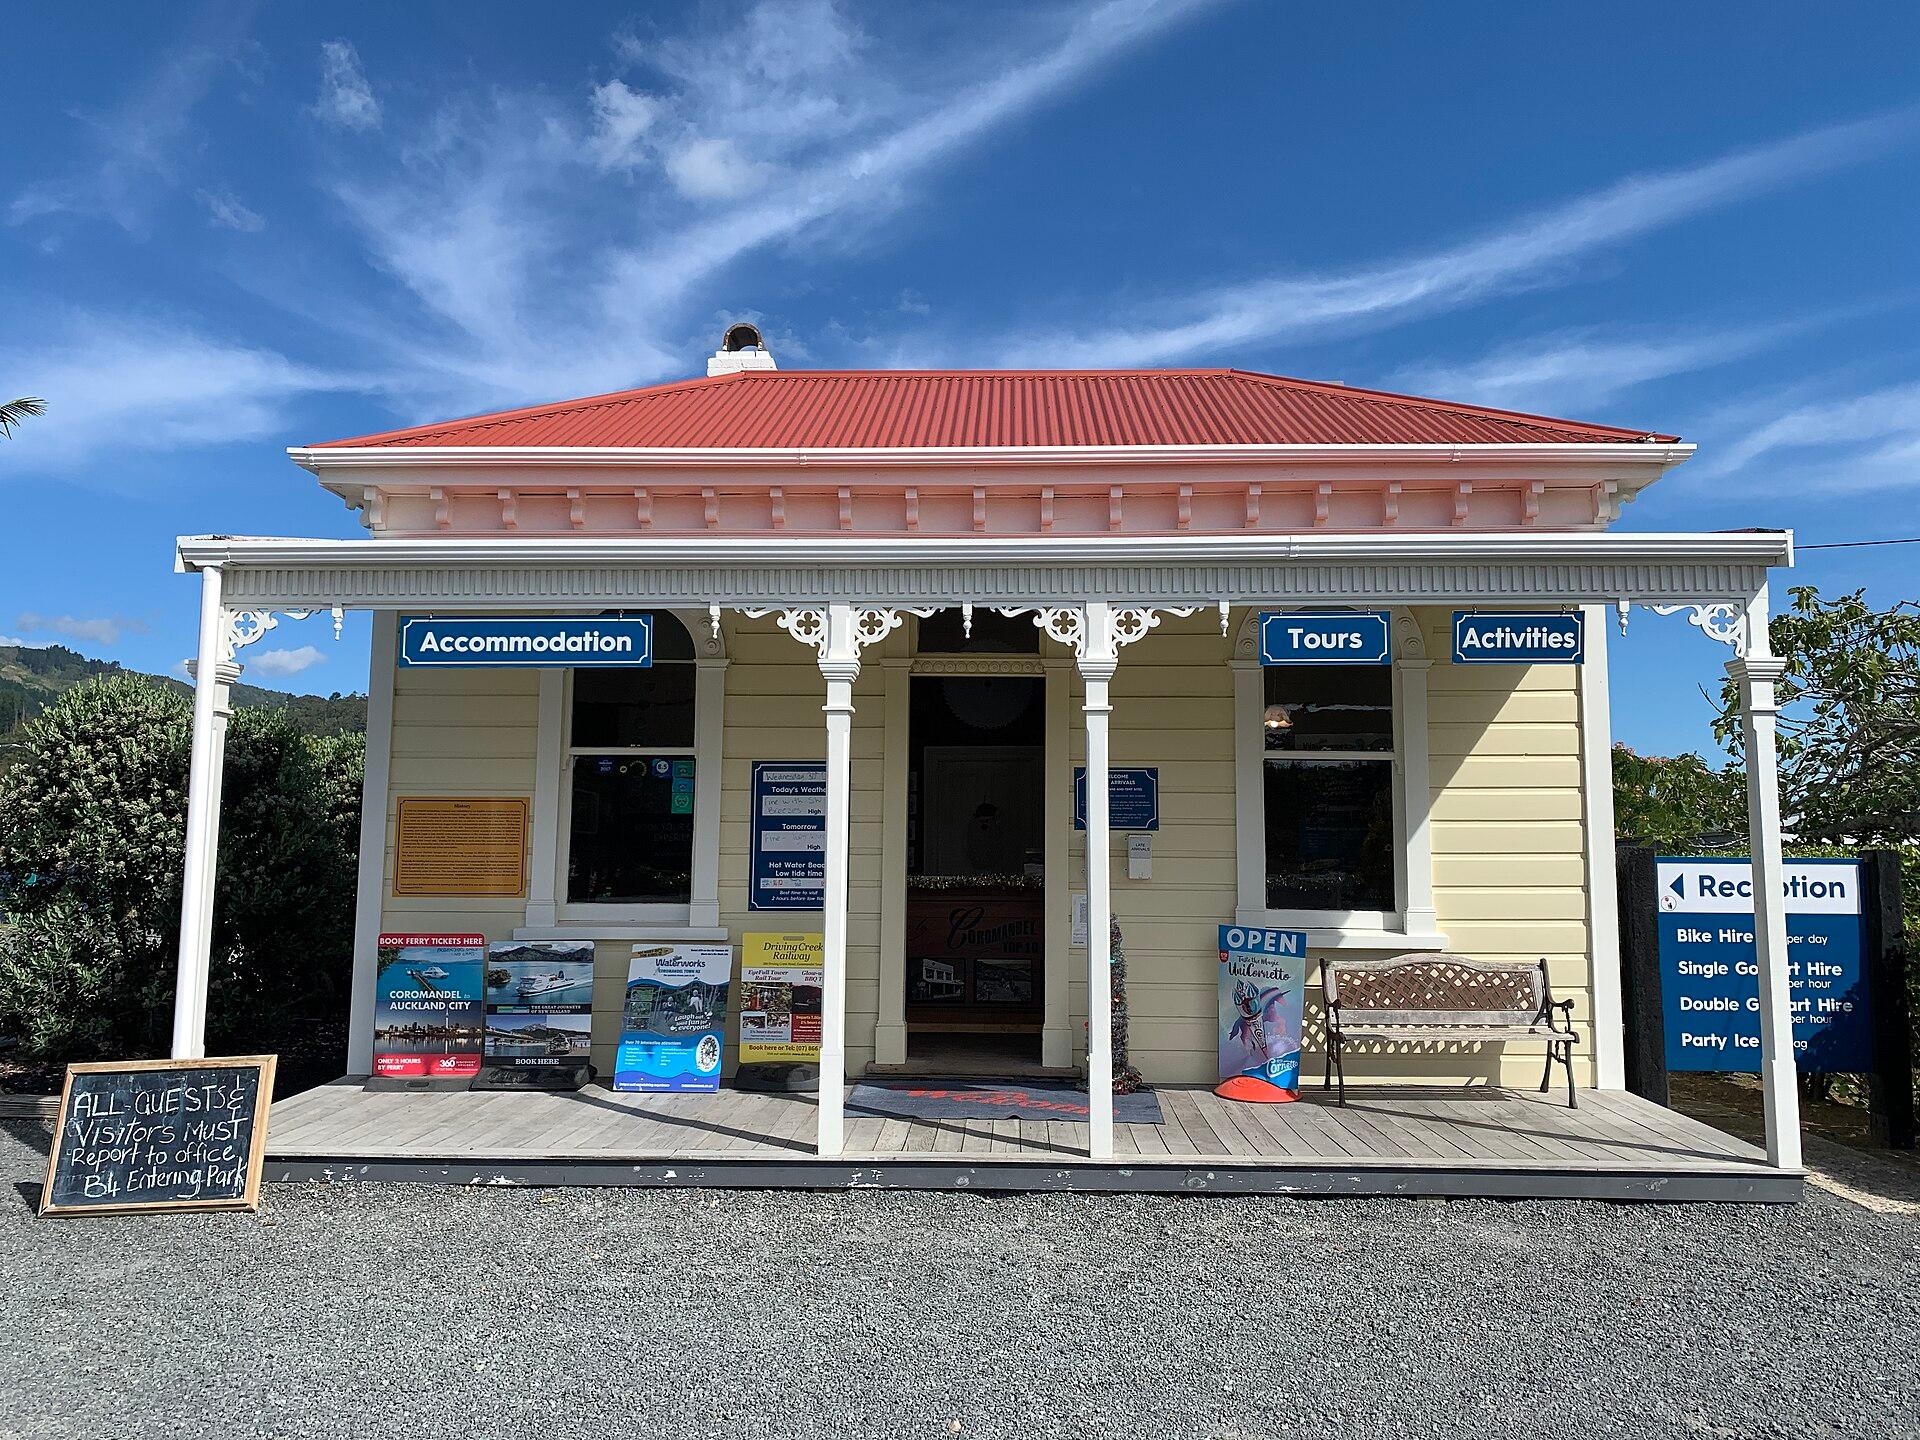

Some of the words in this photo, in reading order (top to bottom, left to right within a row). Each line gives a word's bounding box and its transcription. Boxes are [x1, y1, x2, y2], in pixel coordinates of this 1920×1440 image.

[420, 631, 632, 652] Accommodation
[1287, 628, 1363, 649] Tours
[1462, 626, 1576, 649] Activities
[771, 786, 799, 794] Today's
[1699, 874, 1846, 899] Rection
[380, 937, 404, 945] BOOK
[405, 937, 430, 945] FERRY
[431, 937, 462, 945] TICKETS
[463, 937, 483, 945] HERE
[1226, 928, 1297, 954] OPEN
[1677, 928, 1713, 943] Bike
[1718, 928, 1754, 943] Hire
[1787, 935, 1804, 945] per
[1808, 934, 1828, 946] day
[763, 942, 798, 953] Driving
[798, 942, 824, 952] Creek
[656, 958, 706, 968] Waterworks
[773, 951, 811, 962] Railway
[1678, 961, 1729, 978] Single
[1788, 961, 1800, 976] rt
[1807, 961, 1843, 977] Hire
[1808, 979, 1832, 989] hour
[389, 990, 462, 999] COROMANDEL
[389, 1001, 448, 1010] AUCKLAND
[448, 1001, 472, 1010] CITY
[1680, 996, 1740, 1012] Double
[1745, 997, 1760, 1012] G
[1790, 997, 1811, 1012] art
[1817, 998, 1854, 1012] Hire
[678, 1022, 711, 1031] everyone!
[1810, 1014, 1833, 1024] hour
[1681, 1032, 1727, 1050] Party
[1735, 1033, 1760, 1048] Ice
[1793, 1040, 1808, 1050] ag
[439, 1059, 456, 1067] 360
[74, 1091, 125, 1118] ALL
[75, 1116, 175, 1148] Visitors
[71, 1142, 142, 1173] Report
[145, 1144, 168, 1165] to
[84, 1171, 121, 1199] B4
[127, 1165, 203, 1198] Entering
[206, 1155, 248, 1190] Park
